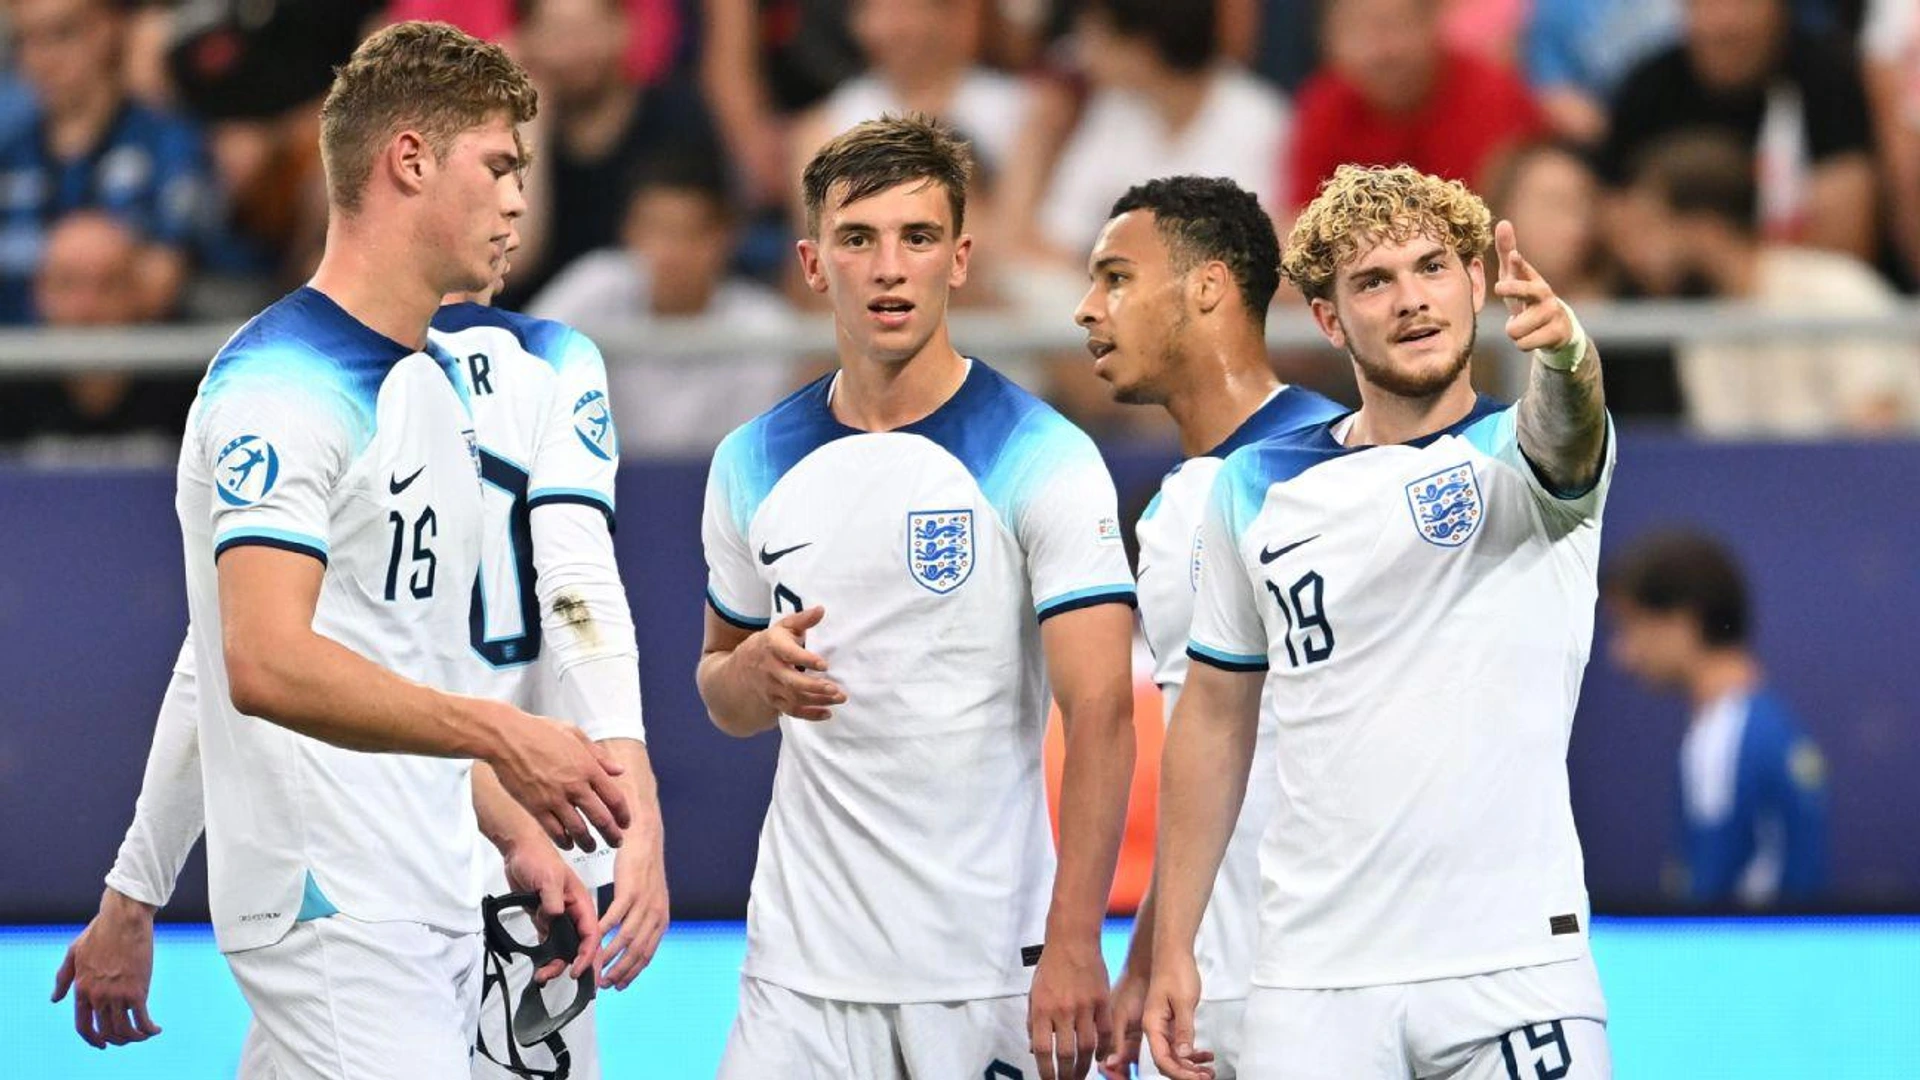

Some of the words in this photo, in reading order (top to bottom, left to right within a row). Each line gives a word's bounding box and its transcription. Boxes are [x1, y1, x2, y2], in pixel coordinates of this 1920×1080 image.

[455, 353, 494, 395] R
[384, 505, 437, 600] 15
[1265, 570, 1335, 668] 19
